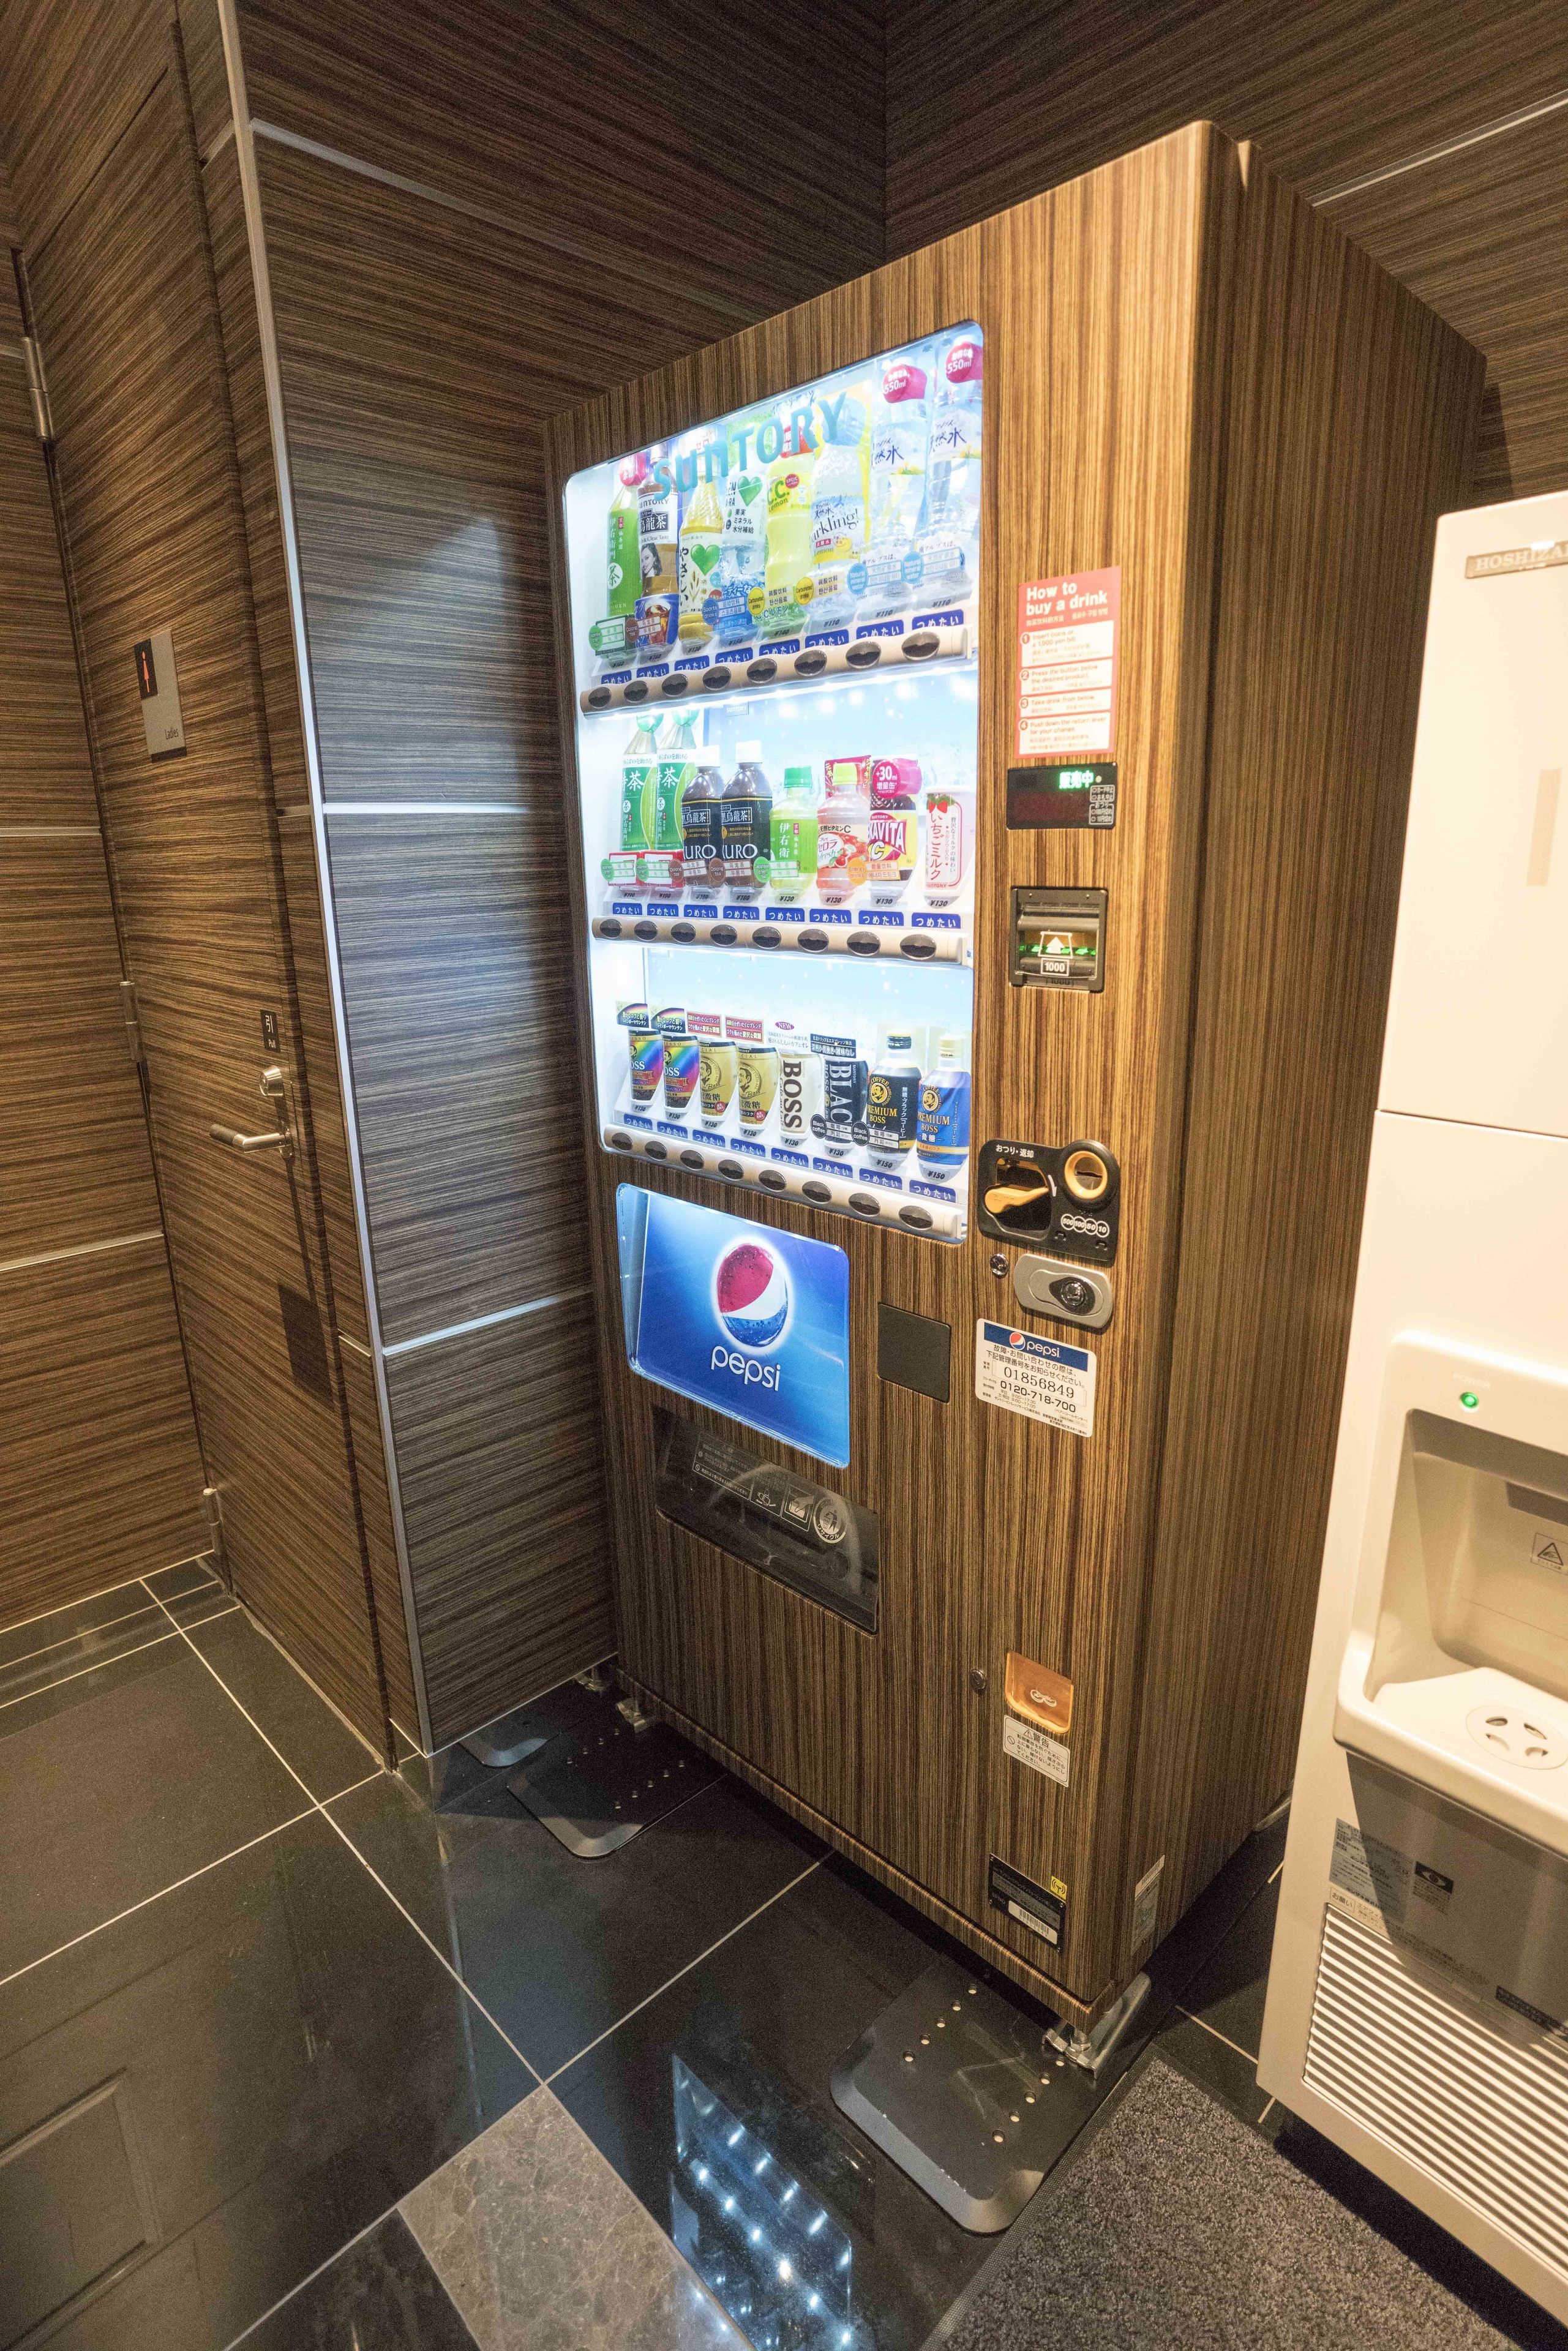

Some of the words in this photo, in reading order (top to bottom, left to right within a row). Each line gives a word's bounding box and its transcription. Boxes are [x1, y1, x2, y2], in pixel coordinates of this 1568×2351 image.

[947, 359, 972, 373] 550ml
[885, 380, 906, 393] 550ml
[768, 498, 788, 512] Lemon
[1027, 586, 1058, 601] How
[1062, 582, 1077, 595] to
[1026, 602, 1052, 616] buy
[1056, 599, 1065, 610] a
[1070, 590, 1108, 609] drink
[917, 615, 959, 628] つめたい
[860, 624, 899, 637] つめたい
[809, 636, 845, 646] つめたい
[763, 645, 797, 655] つめたい
[719, 653, 750, 663] つめたい
[678, 660, 707, 670] つめたい
[604, 675, 629, 684] つめたい
[640, 669, 666, 678] つめたい
[164, 726, 179, 740] Ladies
[1059, 770, 1094, 789] 販売中
[871, 841, 885, 860] C
[930, 813, 942, 880] いちごミルク
[615, 907, 640, 915] つめたい
[650, 907, 677, 916] つめたい
[686, 909, 715, 917] つめたい
[726, 910, 757, 920] つめたい
[768, 911, 801, 921] つめたい
[812, 913, 848, 923] つめたい
[863, 915, 900, 926] つめたい
[915, 917, 956, 928] つめたい
[1045, 962, 1065, 972] 1000
[264, 1015, 274, 1033] 引
[871, 1076, 890, 1086] COFFEE
[782, 1060, 802, 1128] BOSS
[829, 1063, 853, 1125] BLAC
[626, 1118, 650, 1128] つめたい
[869, 1116, 886, 1124] BOSS
[661, 1126, 686, 1137] つめたい
[695, 1134, 723, 1146] つめたい
[921, 1134, 936, 1143] 微糖
[733, 1143, 762, 1155] つめたい
[996, 1144, 1034, 1158] おつり・返却
[774, 1153, 806, 1165] つめたい
[876, 1159, 893, 1168] ¥150
[816, 1163, 850, 1176] つめたい
[928, 1170, 945, 1180] ¥150
[863, 1173, 899, 1188] つめたい
[914, 1185, 952, 1200] つめたい
[1027, 1340, 1060, 1359] pepsi
[994, 1344, 1078, 1378] 故障・お問い合わせの際は、
[710, 1345, 781, 1392] pepsi
[986, 1349, 1085, 1389] 下記管理番号をお知らせください。
[1004, 1366, 1075, 1399] 01856849
[1000, 1381, 1076, 1413] 0120-718-700
[1033, 1733, 1049, 1749] 警告
[1017, 1750, 1041, 1767] てください。
[1332, 1892, 1353, 1908] お願い
